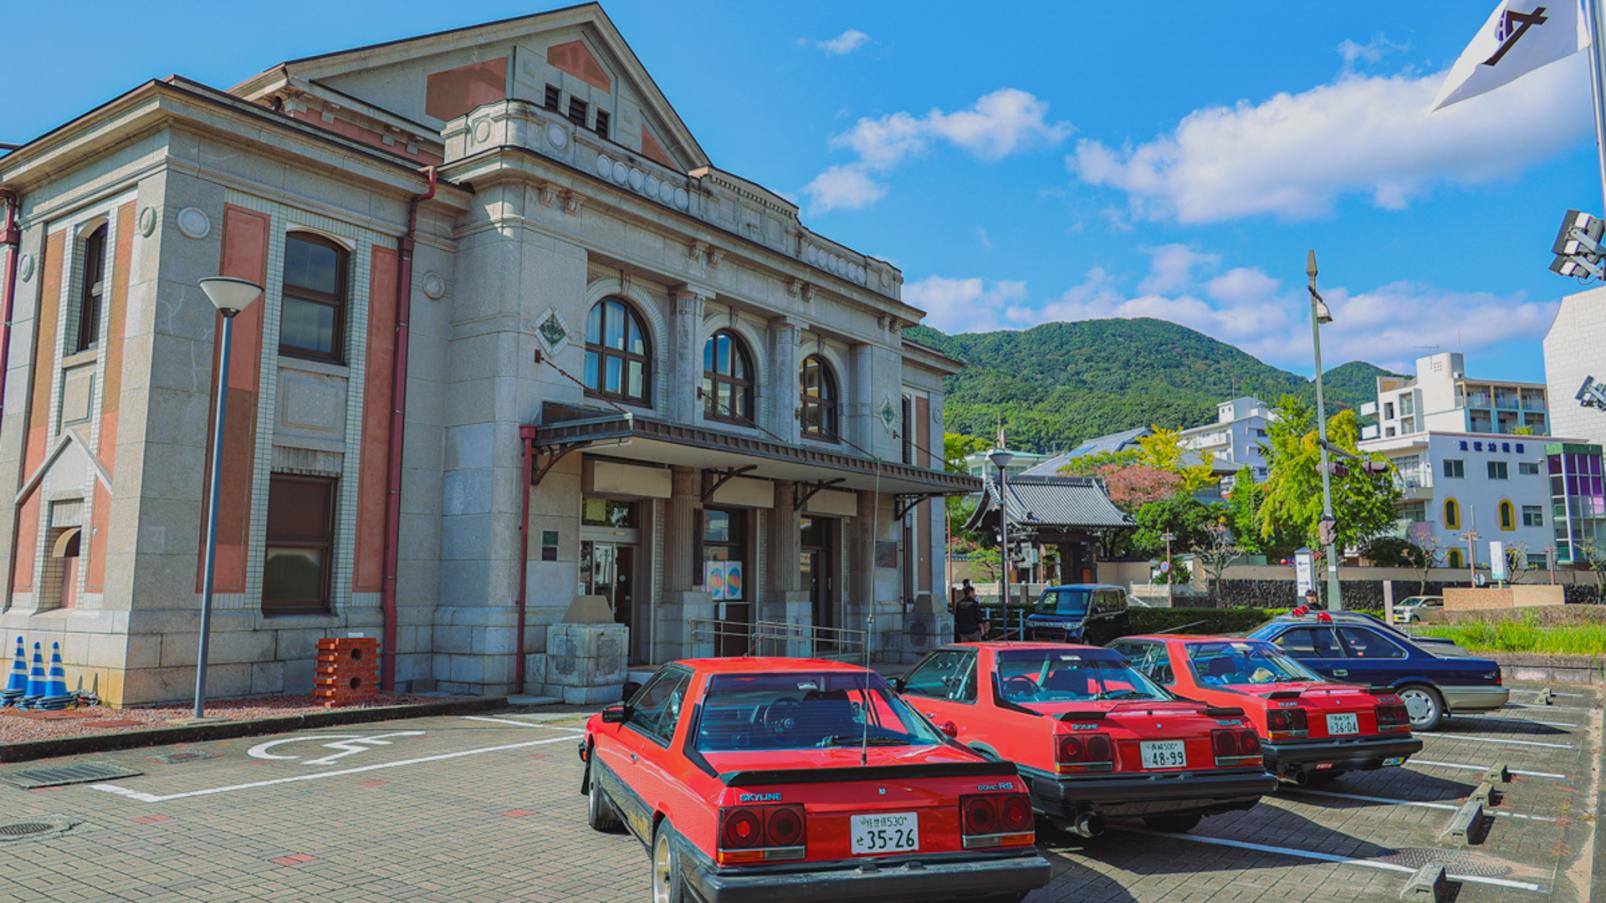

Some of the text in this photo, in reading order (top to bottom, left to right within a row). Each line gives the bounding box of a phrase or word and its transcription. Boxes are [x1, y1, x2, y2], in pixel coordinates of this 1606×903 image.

[1152, 751, 1184, 766] 48-99
[739, 791, 782, 802] SKYLINE
[866, 828, 915, 850] 35-26
